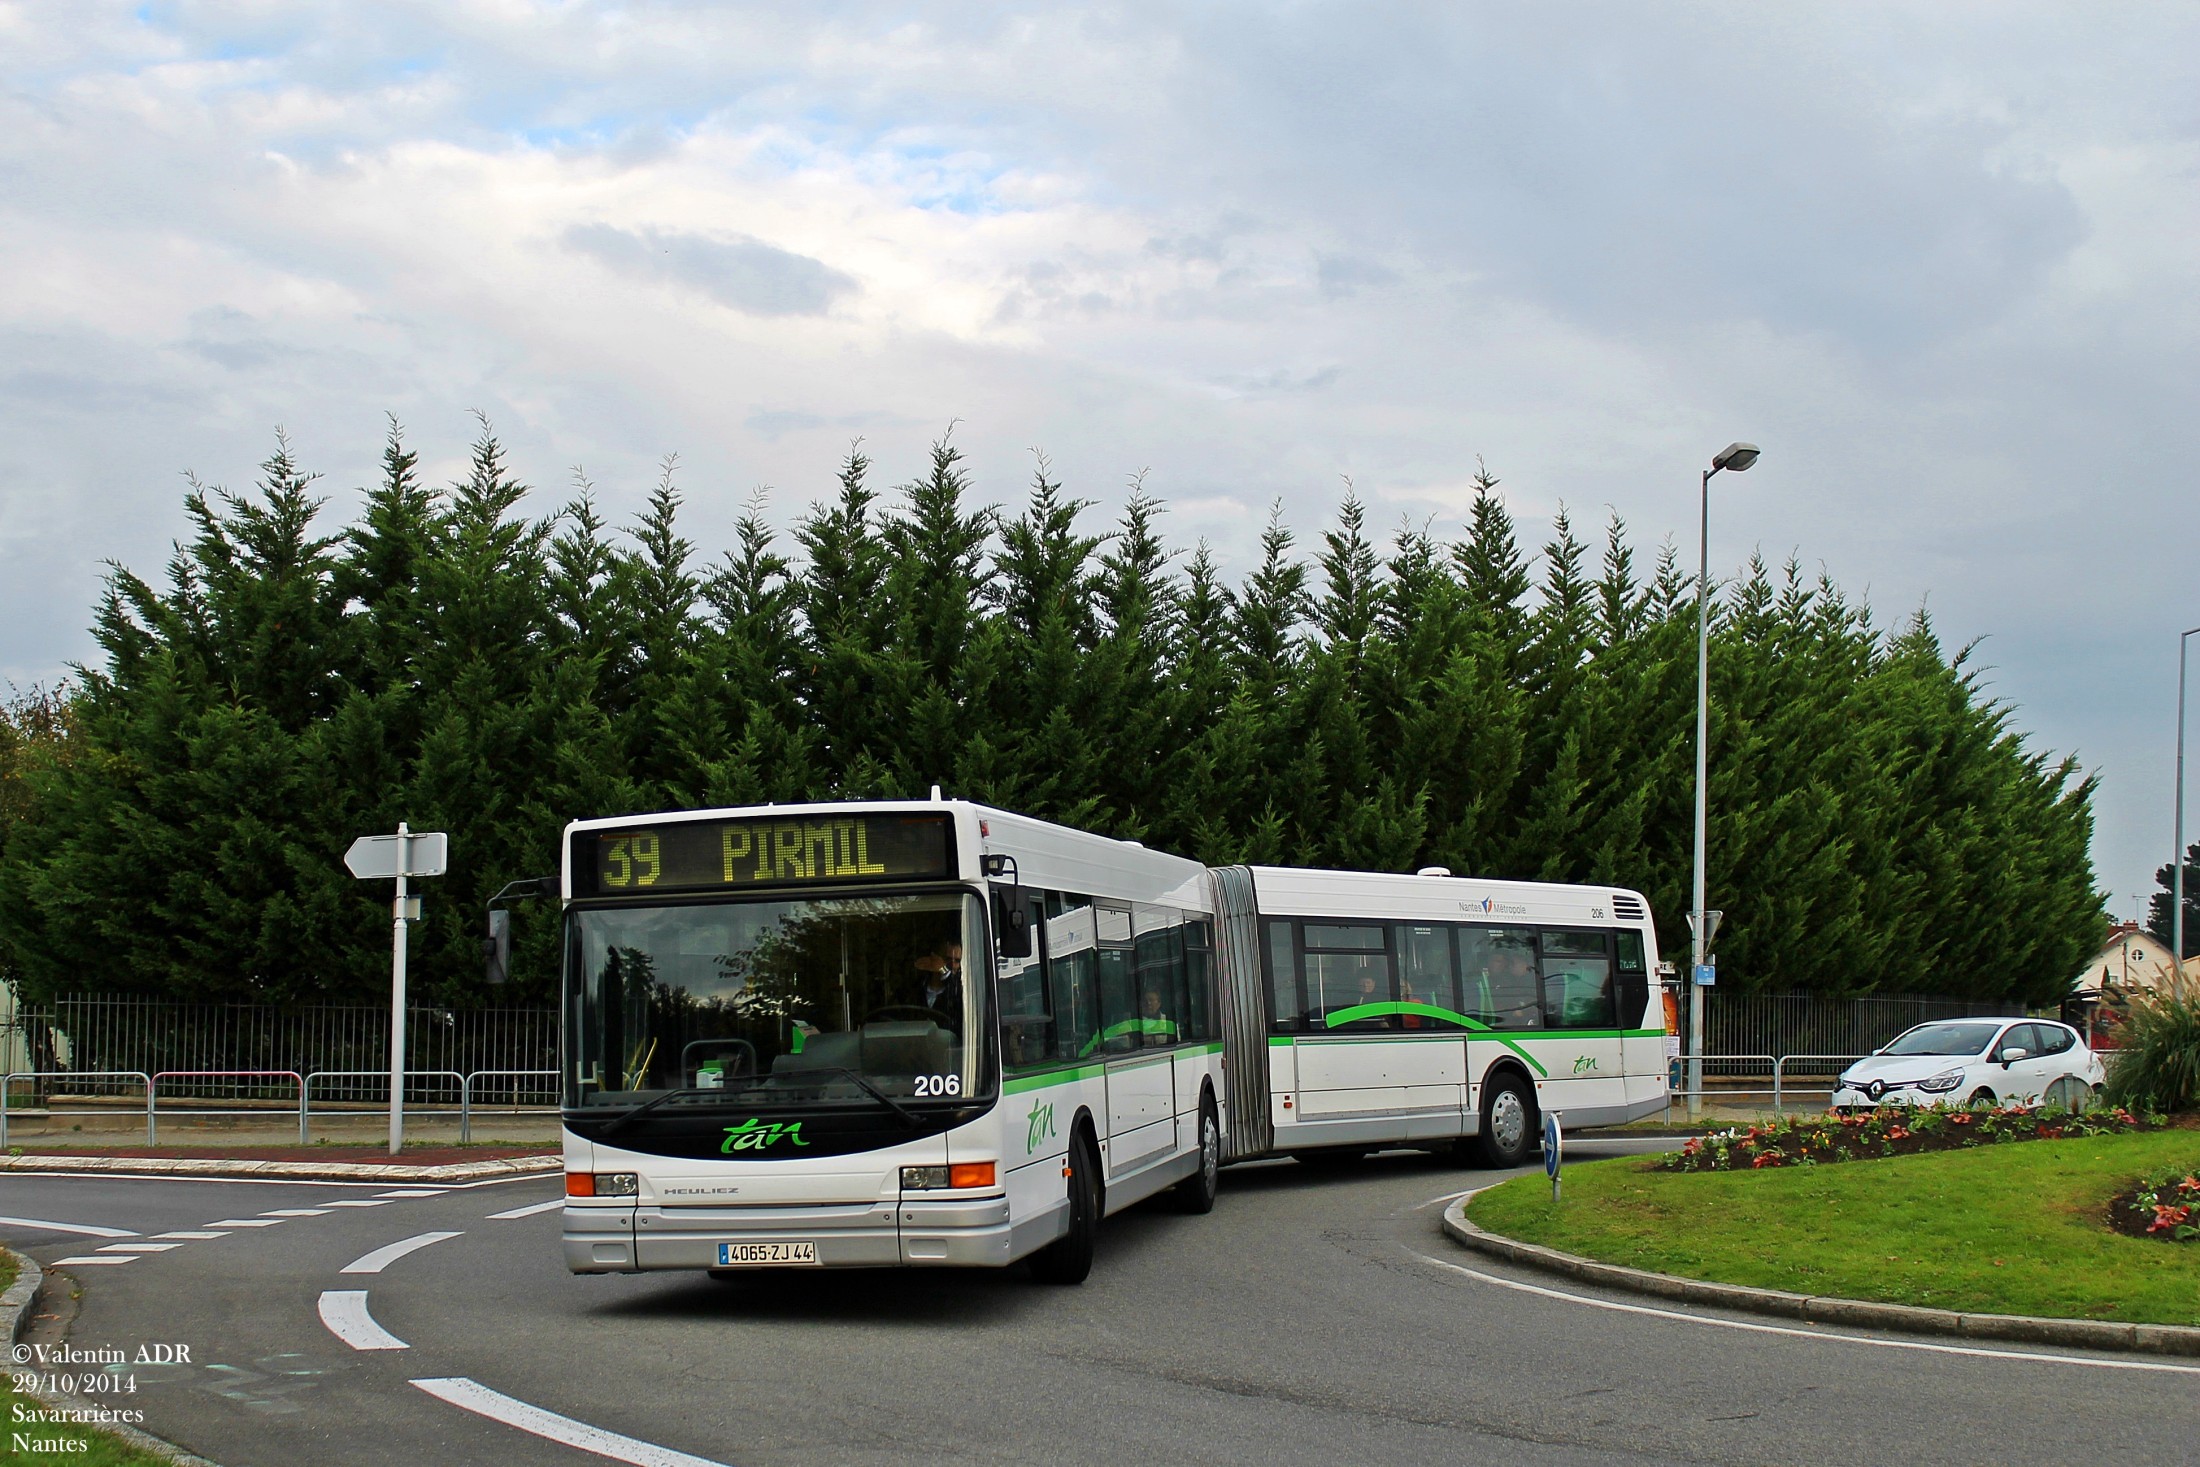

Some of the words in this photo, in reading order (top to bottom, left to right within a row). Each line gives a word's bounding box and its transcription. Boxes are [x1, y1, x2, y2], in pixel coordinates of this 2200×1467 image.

[603, 830, 661, 887] 39
[722, 819, 885, 882] PIRMIL
[1458, 901, 1482, 913] Nantes
[1494, 903, 1527, 916] Métropole
[1591, 908, 1604, 919] 206
[1573, 1055, 1598, 1074] tan
[914, 1074, 960, 1097] 206
[721, 1118, 810, 1154] tan
[1027, 1097, 1056, 1155] tan
[664, 1187, 740, 1195] HEULIEZ
